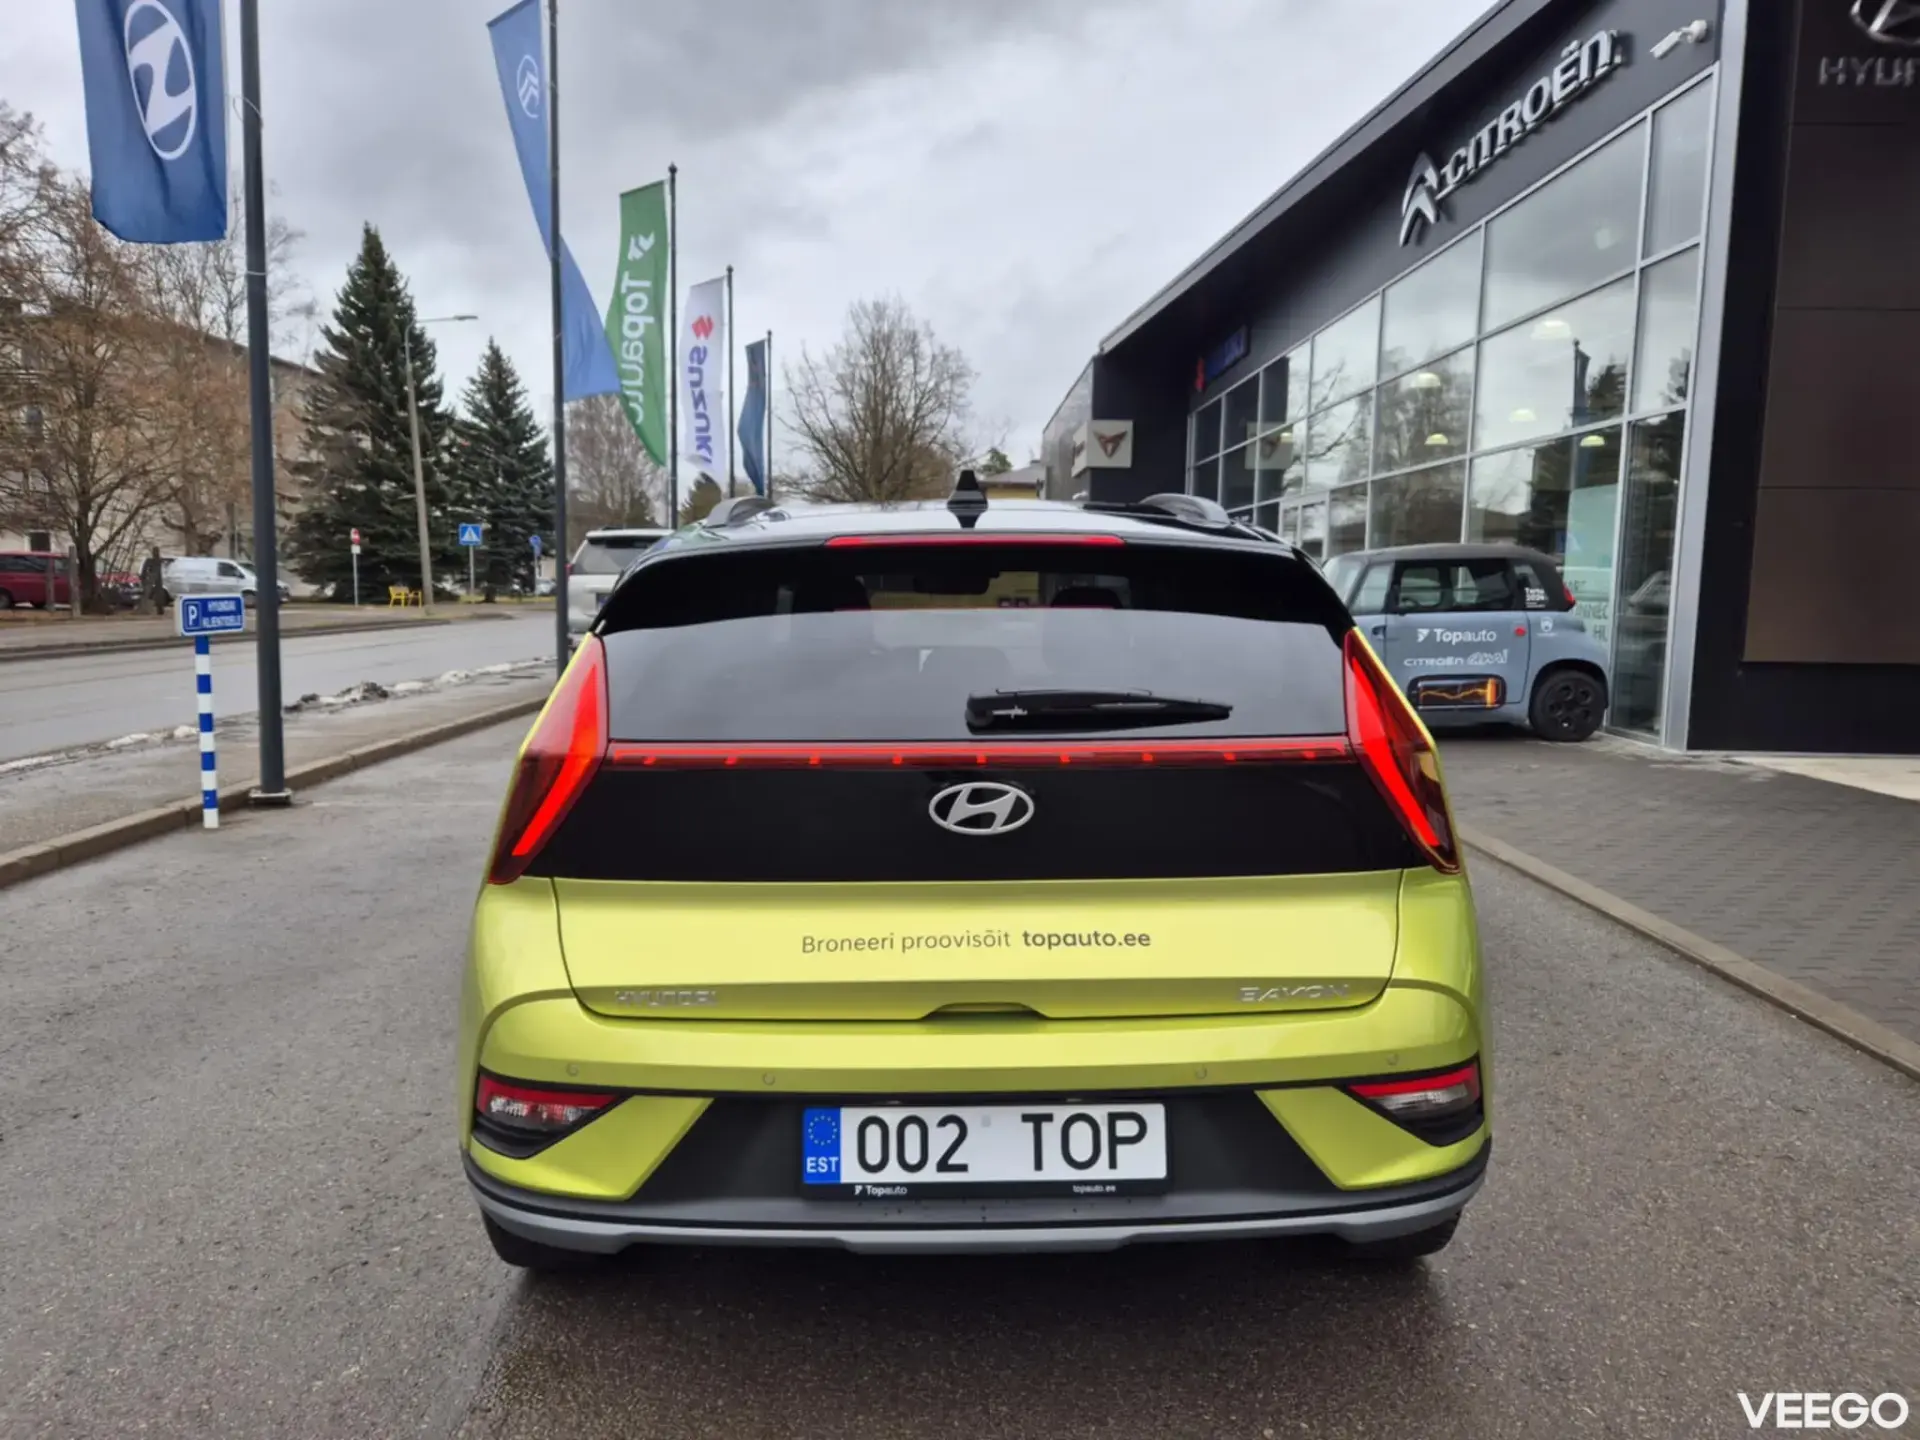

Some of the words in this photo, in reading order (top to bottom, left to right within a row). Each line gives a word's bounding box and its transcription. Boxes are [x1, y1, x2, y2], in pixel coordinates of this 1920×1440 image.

[1432, 627, 1498, 646] Topauto
[801, 932, 895, 953] Broneeri
[901, 930, 1011, 957] proovisõit
[1022, 930, 1151, 950] topauto.ee
[615, 989, 718, 1007] HYUNDAI
[1239, 984, 1350, 1003] BAYON
[857, 1114, 969, 1173] 002
[1021, 1111, 1148, 1171] TOP
[806, 1157, 839, 1173] EST
[866, 1184, 908, 1197] Topauto
[1072, 1184, 1117, 1194] topauto.ee
